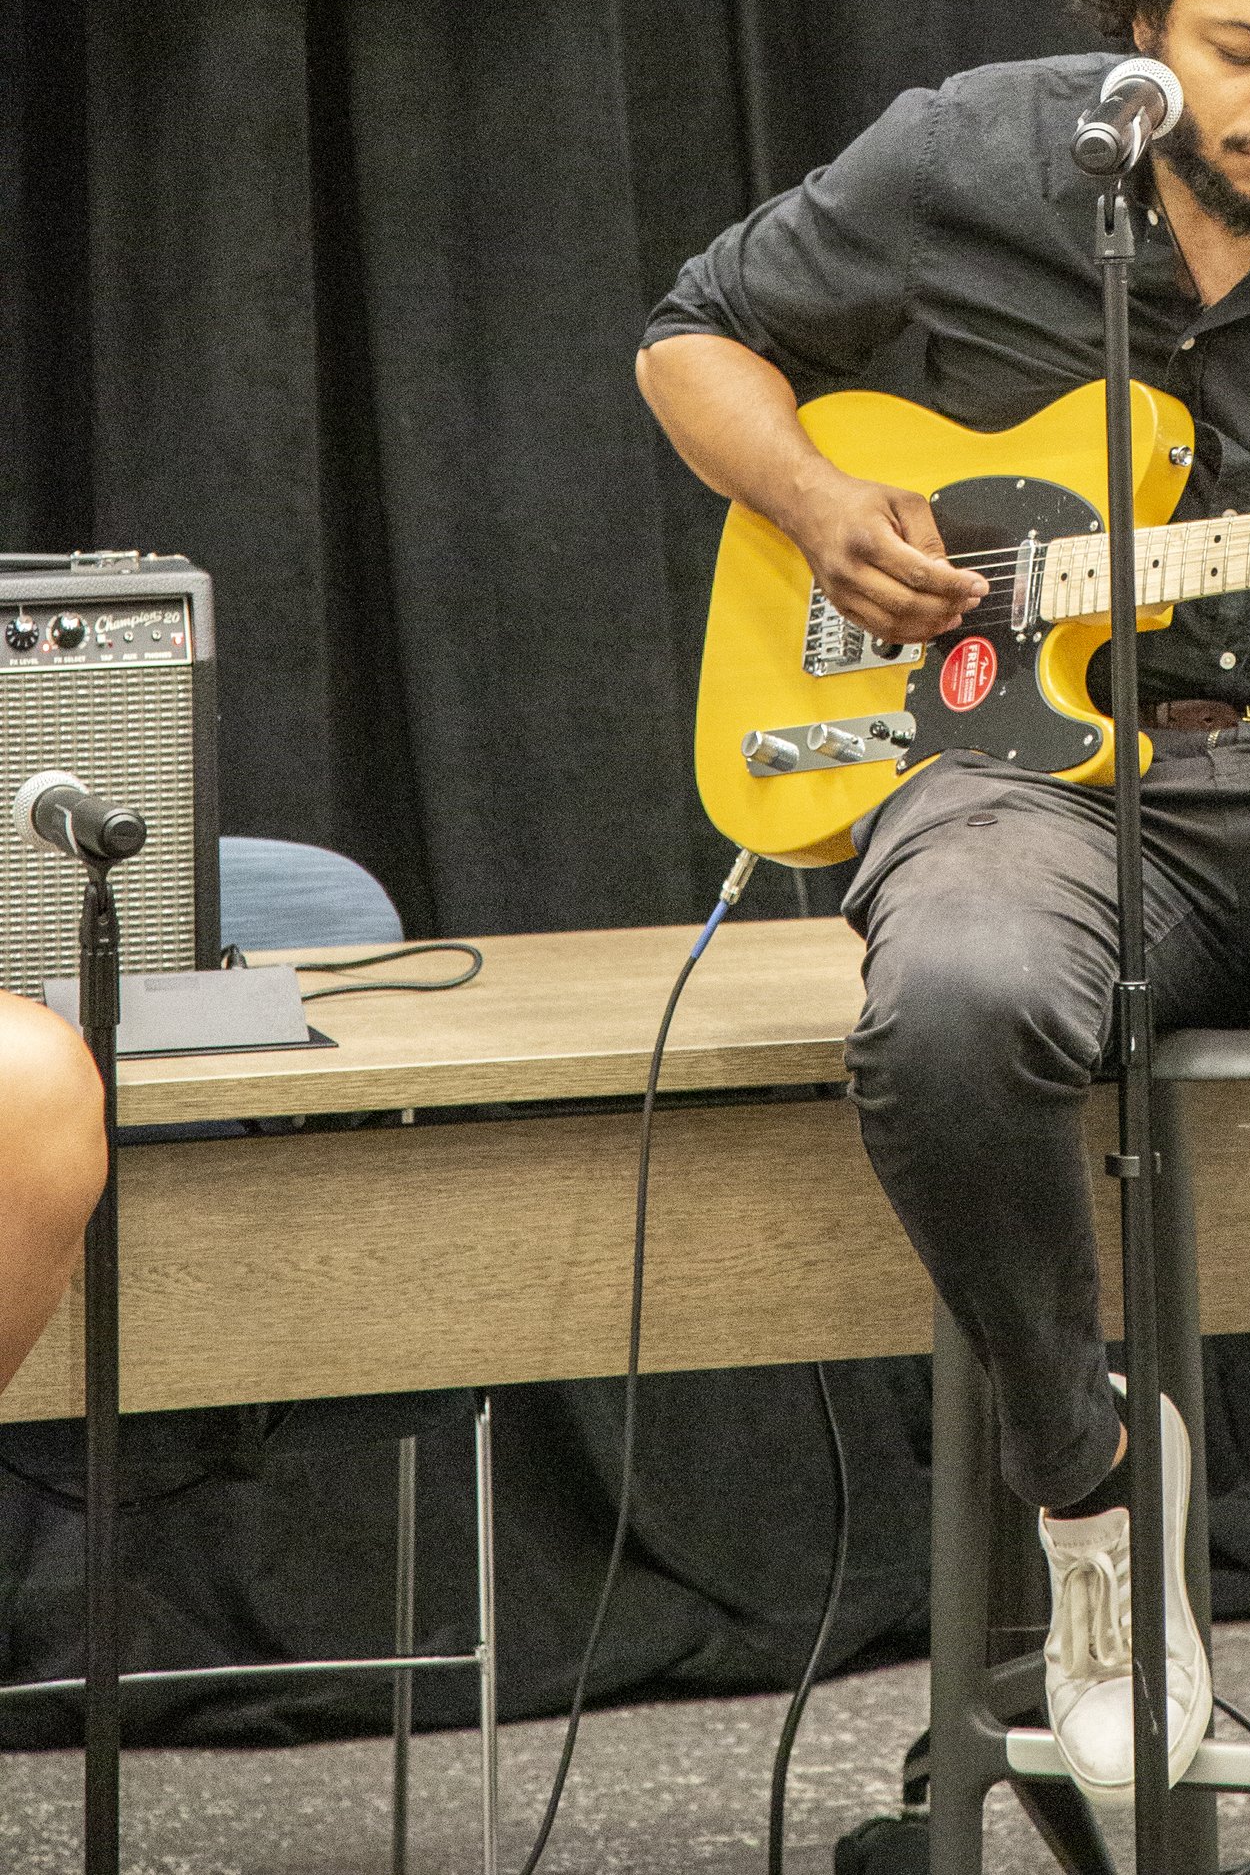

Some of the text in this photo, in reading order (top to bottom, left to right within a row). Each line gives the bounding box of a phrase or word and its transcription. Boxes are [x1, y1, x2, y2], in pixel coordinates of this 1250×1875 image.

[94, 611, 180, 634] Champion 20
[965, 644, 978, 678] FREE
